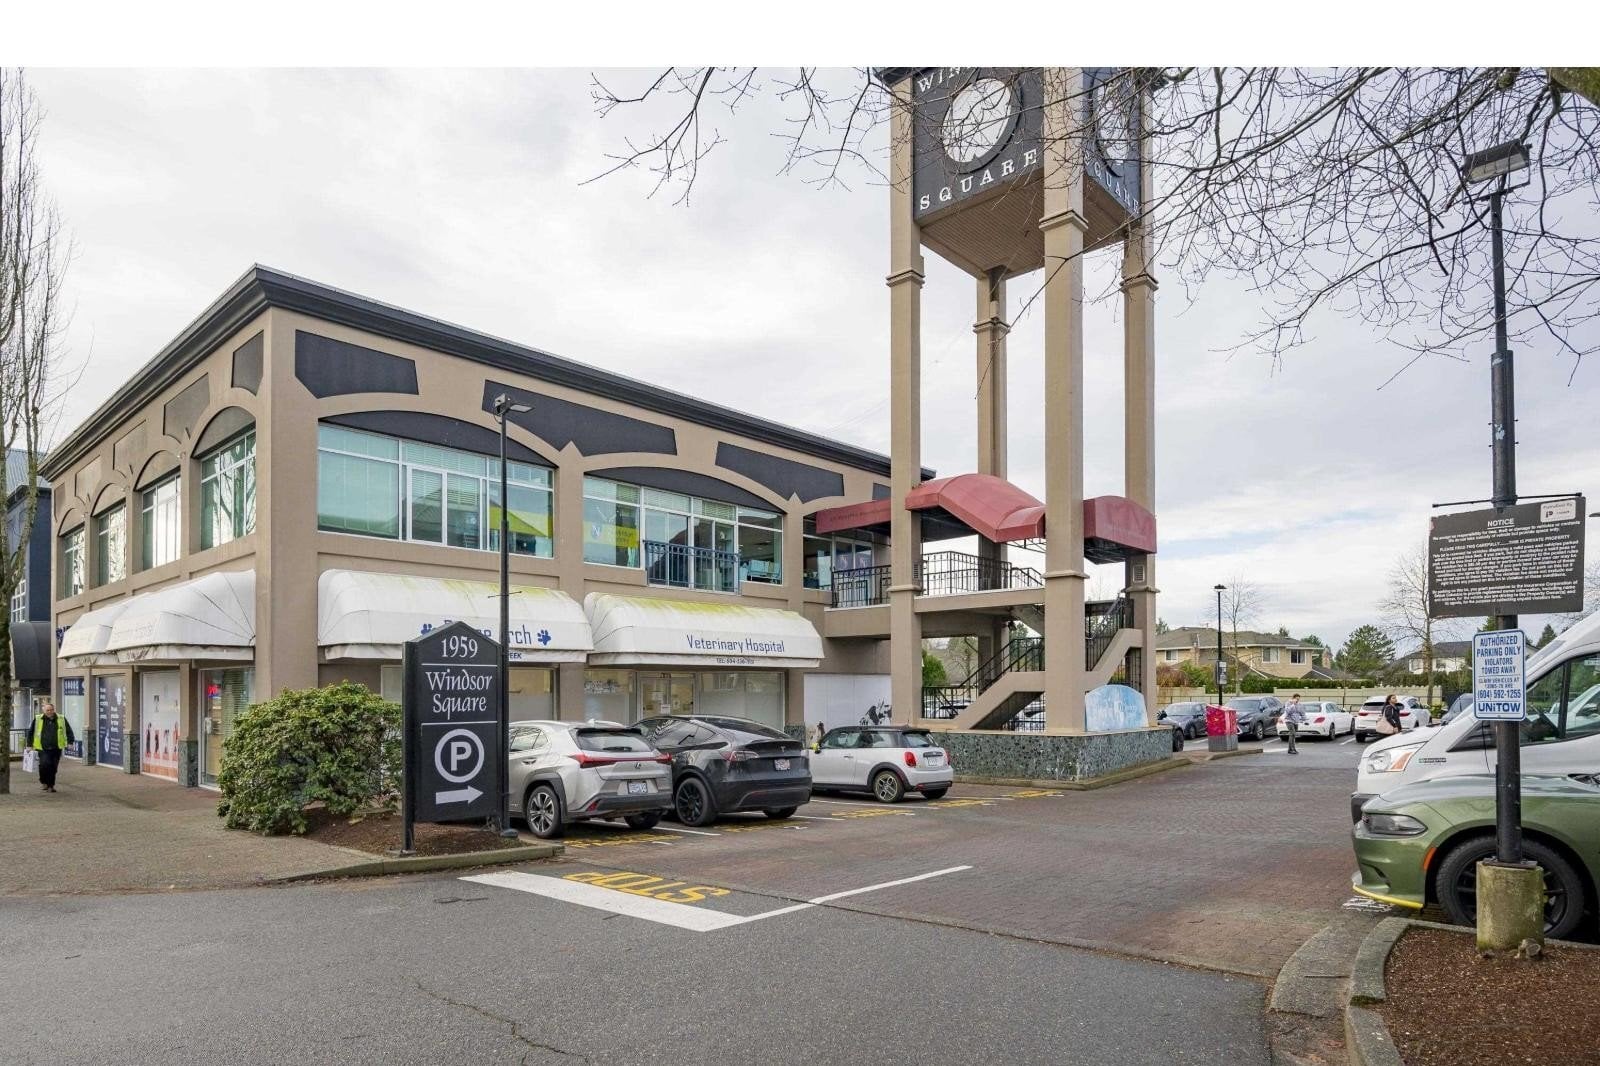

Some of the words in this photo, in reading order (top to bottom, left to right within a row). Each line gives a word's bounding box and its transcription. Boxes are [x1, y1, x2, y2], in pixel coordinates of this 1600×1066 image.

[919, 148, 1038, 210] SQUARE
[1487, 518, 1514, 527] NOTICE
[441, 635, 478, 658] 1959
[686, 634, 744, 653] Veterinary
[745, 638, 785, 653] Hospital
[1480, 635, 1518, 647] AUTHORIZED
[1476, 647, 1503, 657] PARKING
[1504, 646, 1521, 656] ONLY
[1484, 657, 1513, 666] VIOLATORS
[1481, 667, 1499, 675] TOWED
[1500, 666, 1516, 674] AWAY
[425, 669, 493, 691] Windsor
[1477, 690, 1492, 699] (604)
[433, 693, 487, 720] Square
[562, 871, 732, 903] STOP
